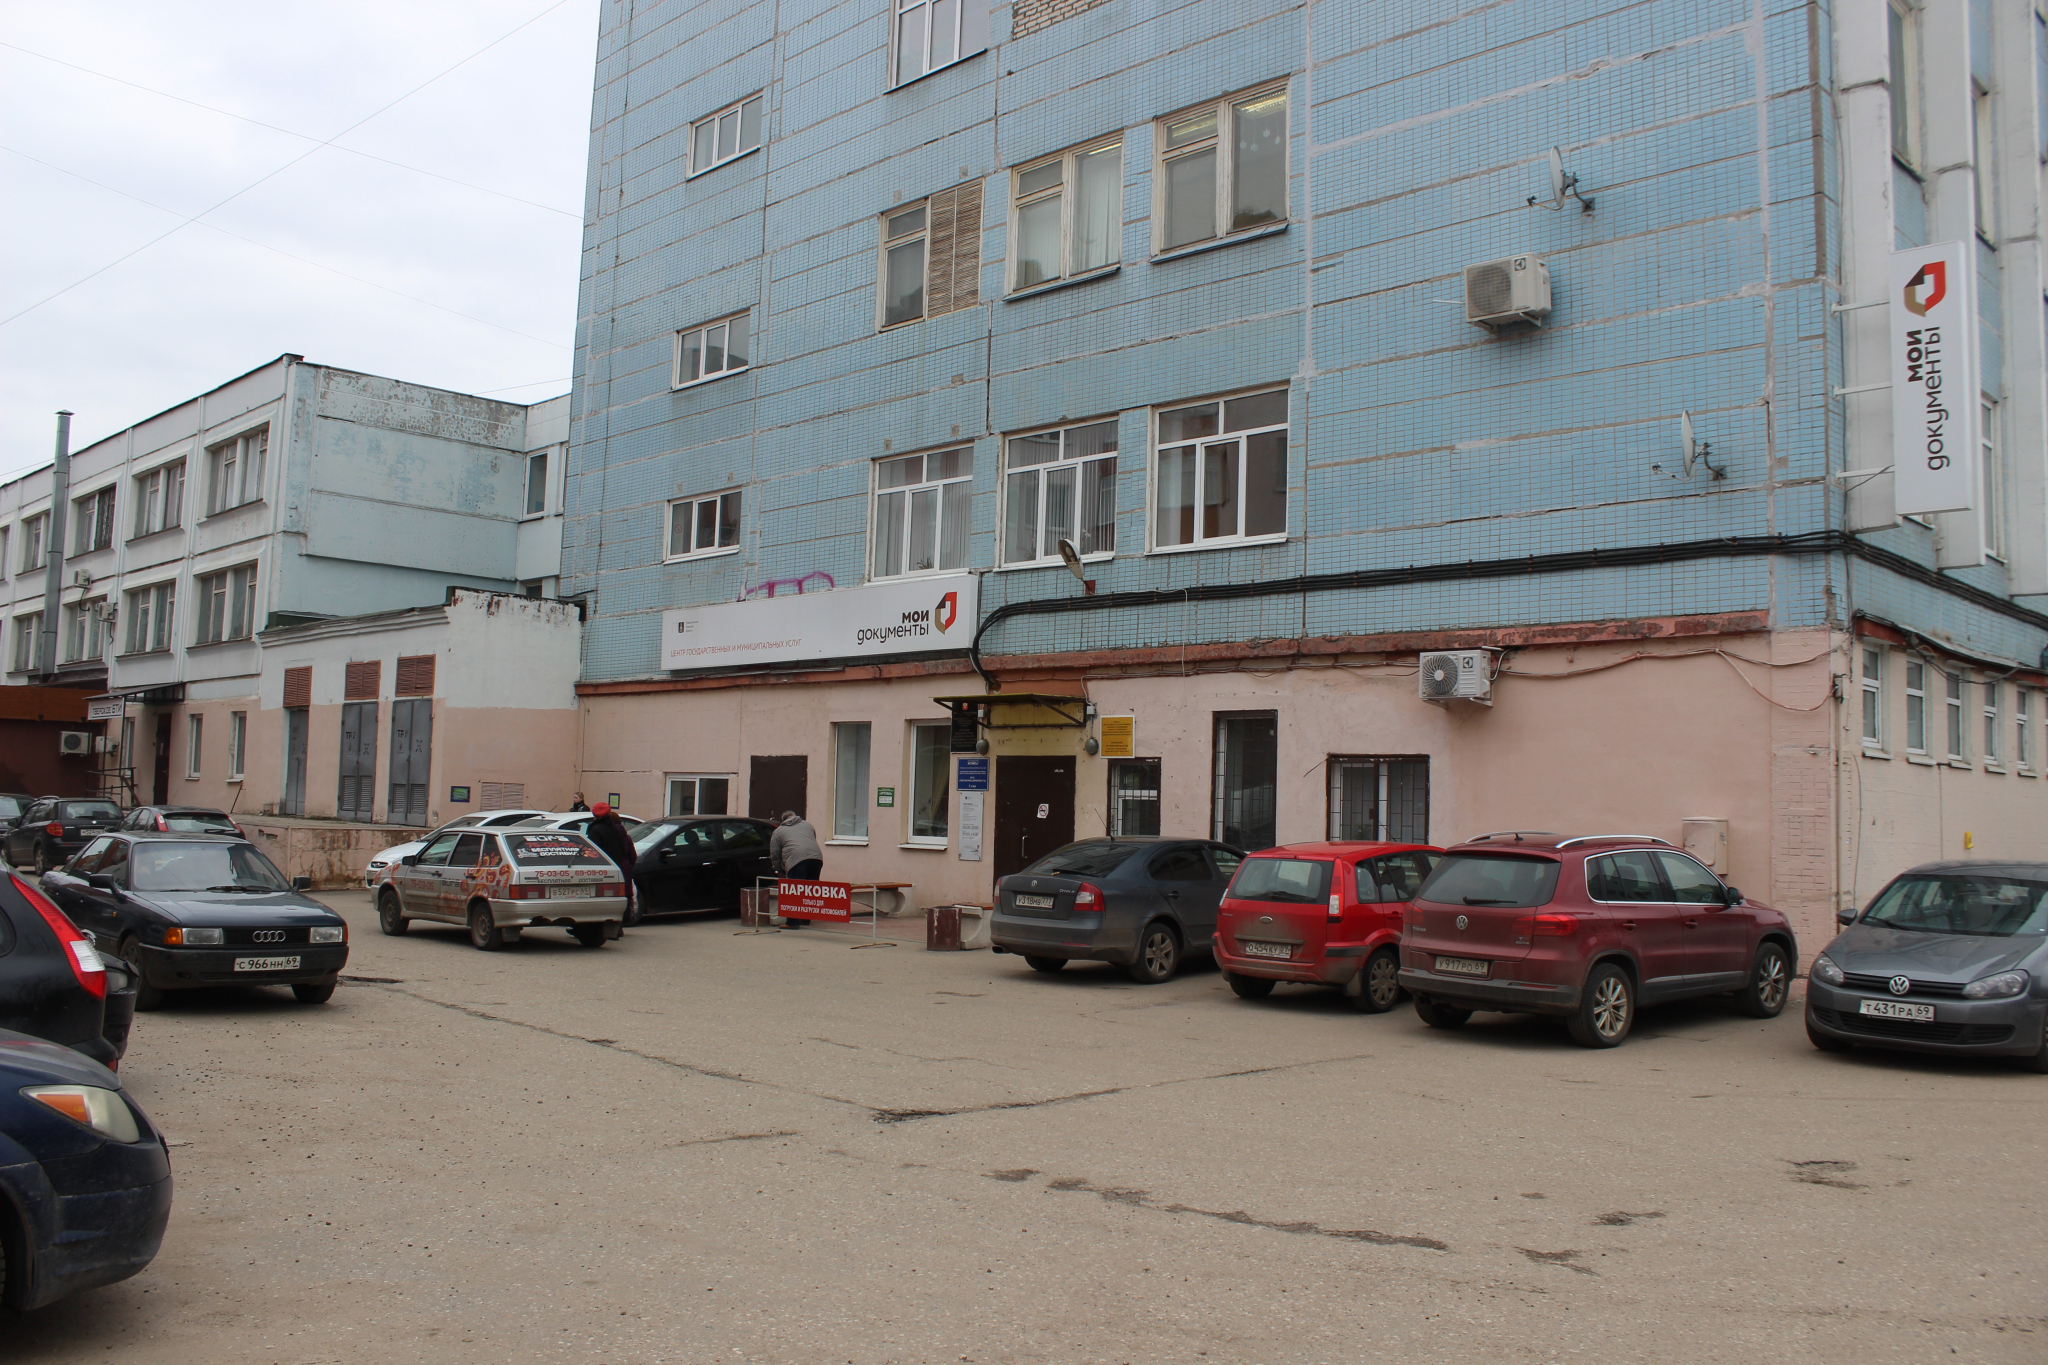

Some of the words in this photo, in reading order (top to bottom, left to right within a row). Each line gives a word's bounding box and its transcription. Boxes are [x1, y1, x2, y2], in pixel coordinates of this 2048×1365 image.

[1906, 329, 1924, 382] мои
[1924, 326, 1950, 471] документы
[902, 610, 929, 623] мои
[857, 623, 929, 645] документы
[670, 648, 686, 657] ЦЕНТР
[686, 645, 731, 656] ГОСУДАРСТВЕННЫХ
[736, 641, 784, 652] МУНИЦИПАЛЬНЫХ
[785, 639, 802, 648] УСЛУГ
[780, 883, 847, 899] ПАРКОВКА
[801, 906, 819, 914] РАЗГРУЗКИ
[821, 908, 847, 916] АВТОМОБИЛЕЙ
